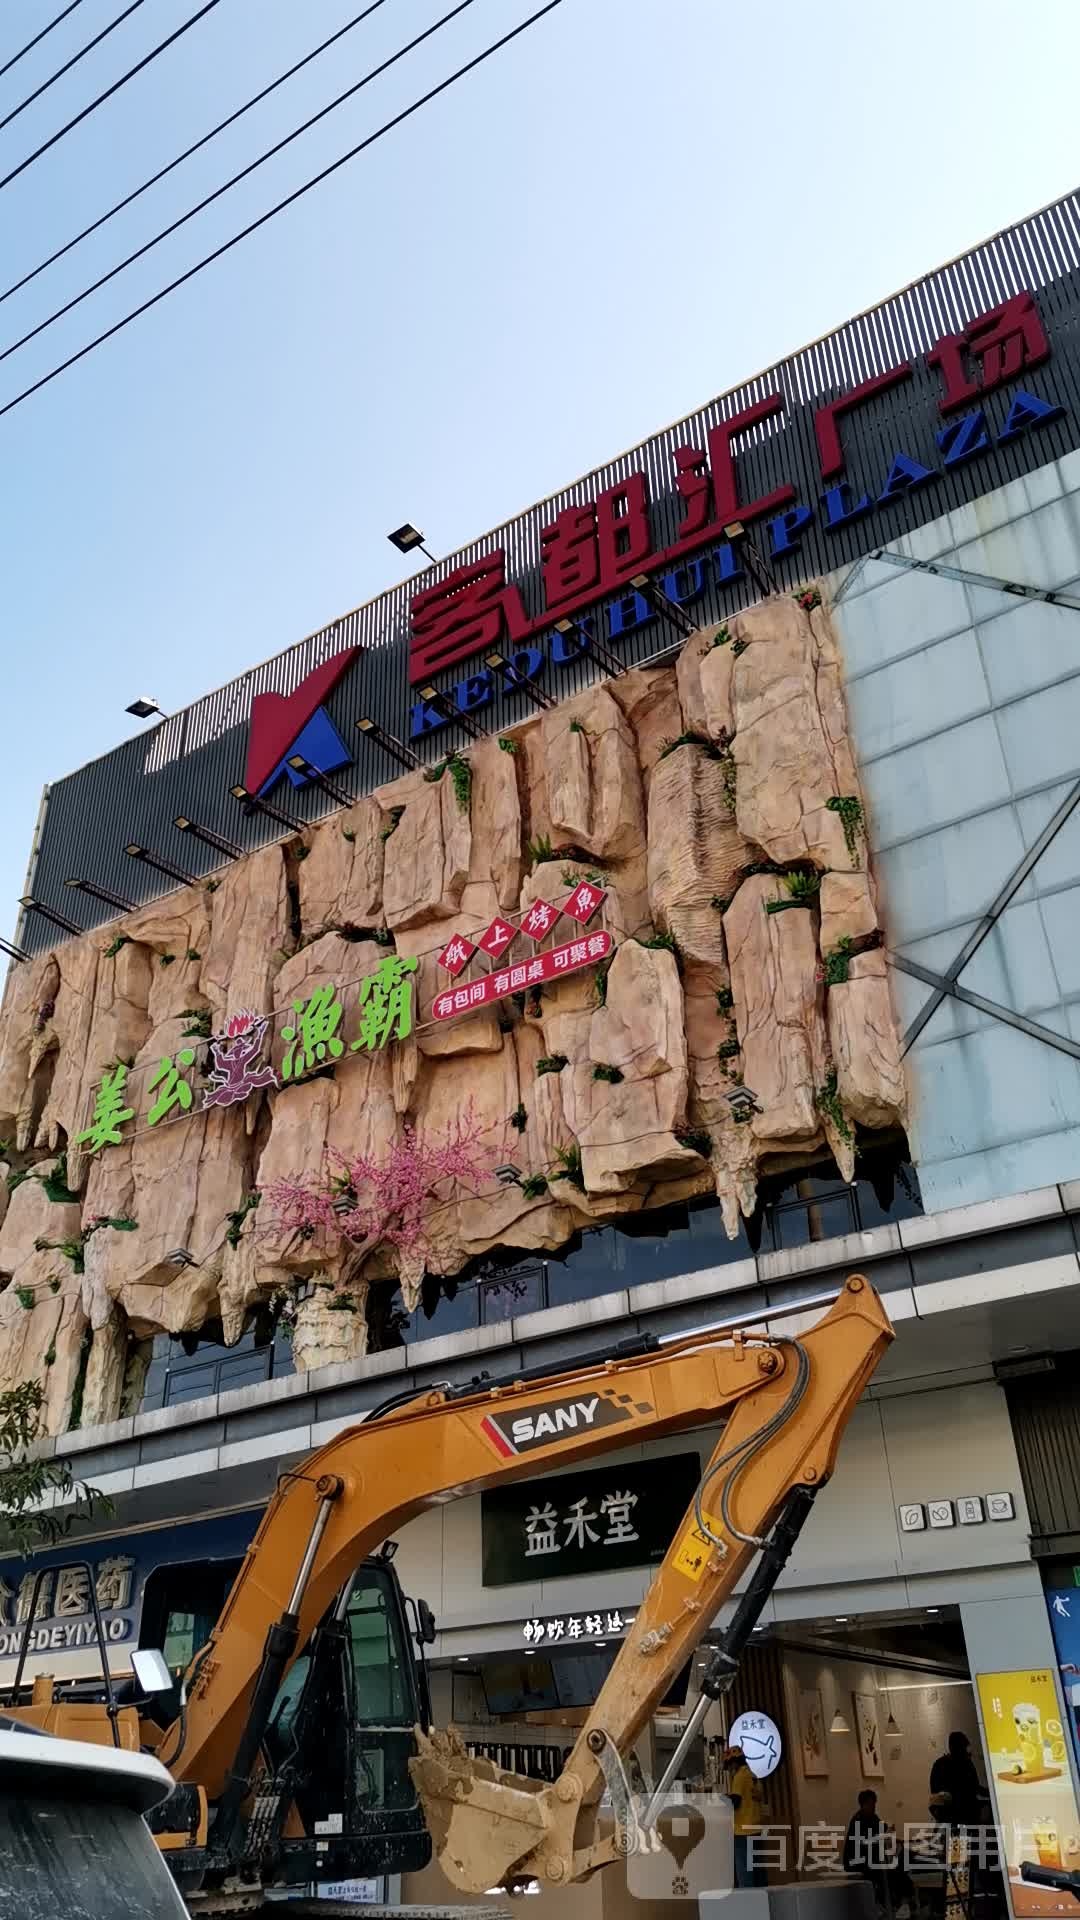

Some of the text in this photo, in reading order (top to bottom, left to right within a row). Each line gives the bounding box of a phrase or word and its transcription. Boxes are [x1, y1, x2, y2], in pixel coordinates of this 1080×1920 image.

[408, 290, 1053, 686] 客都汇广场
[408, 388, 1068, 744] KEDUHUI PLAZA
[438, 934, 605, 1016] 有包间 有圆桌 可聚餐
[512, 1397, 600, 1444] SANY
[524, 1489, 640, 1557] 益禾堂
